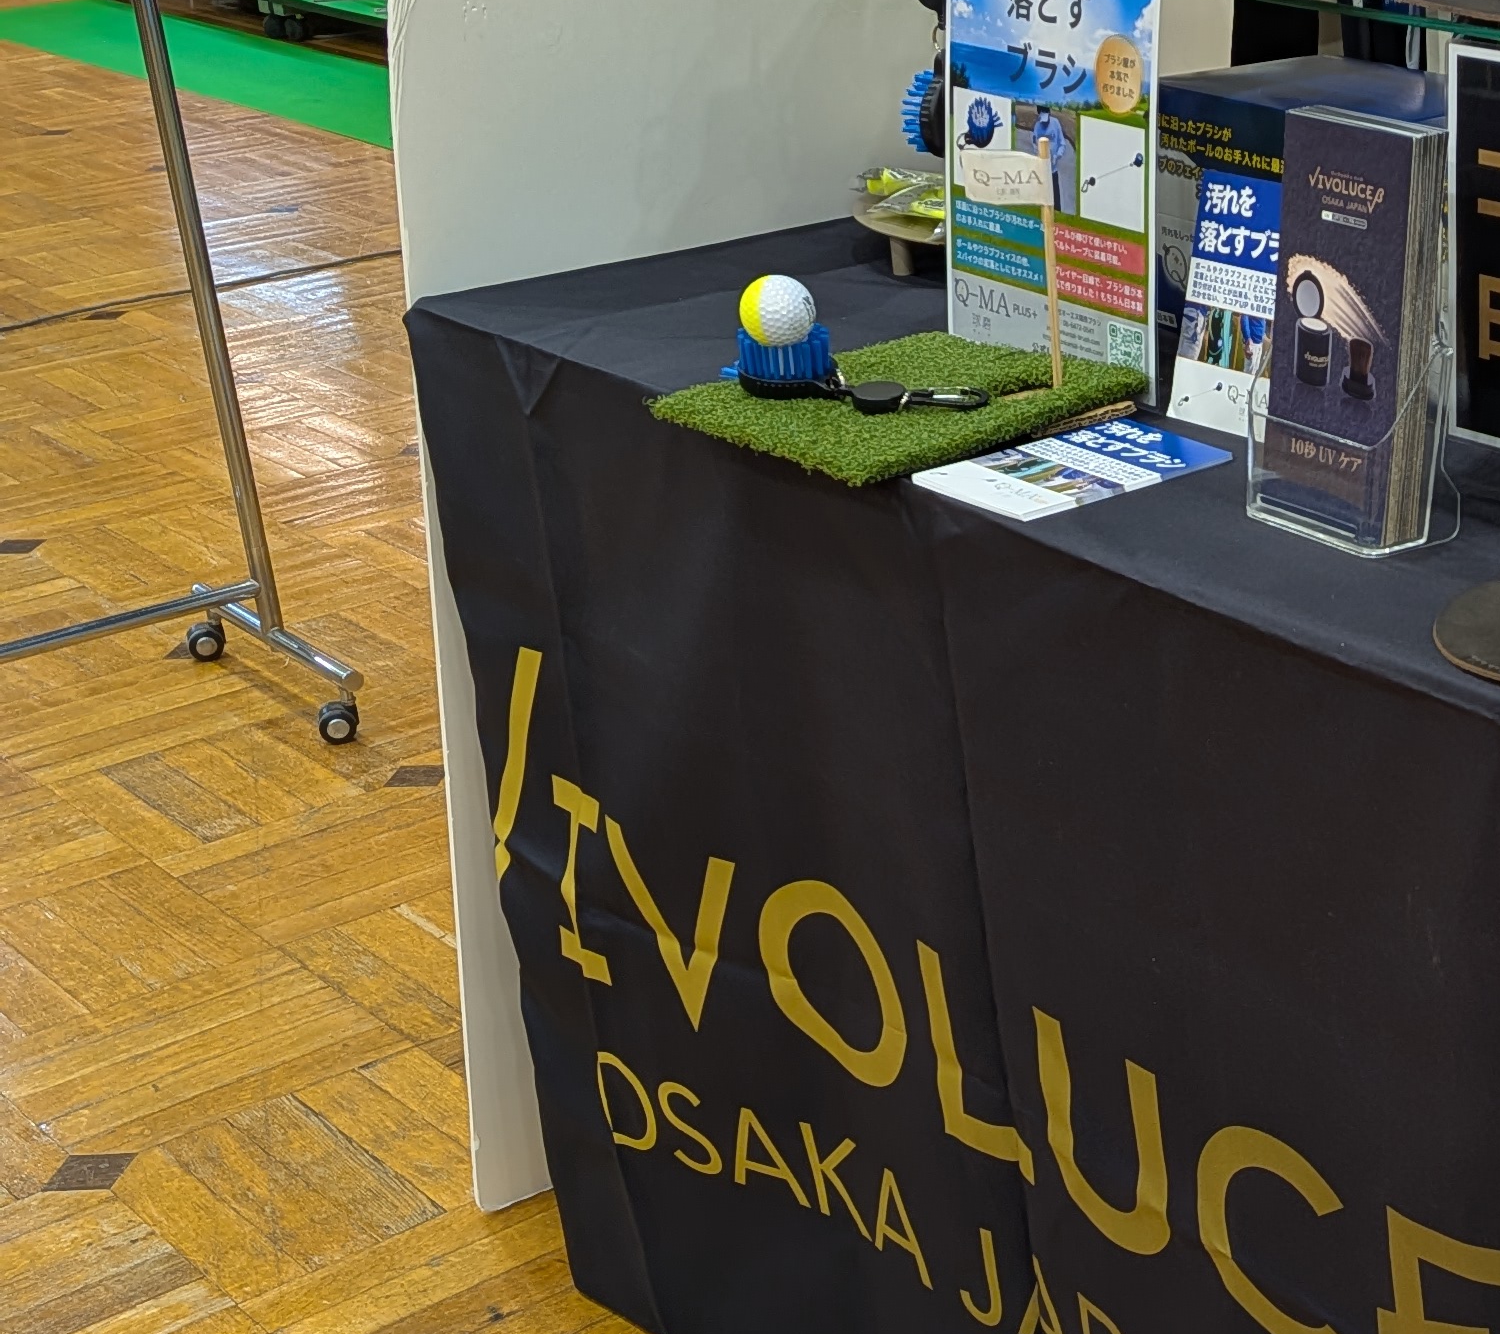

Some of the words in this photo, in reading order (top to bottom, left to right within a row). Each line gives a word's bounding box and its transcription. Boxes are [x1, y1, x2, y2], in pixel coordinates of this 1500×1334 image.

[1007, 42, 1087, 95] ブラシ
[972, 167, 1044, 187] Q-MA
[1205, 181, 1257, 218] 汚れを
[1322, 195, 1345, 208] OSAKA
[954, 277, 1011, 318] Q-MA
[1013, 302, 1038, 319] PLUS+
[1056, 279, 1143, 313] で作りました！もちろん日本製
[1290, 436, 1317, 460] 10秒
[1318, 440, 1337, 466] UV
[1338, 454, 1363, 473] ケア
